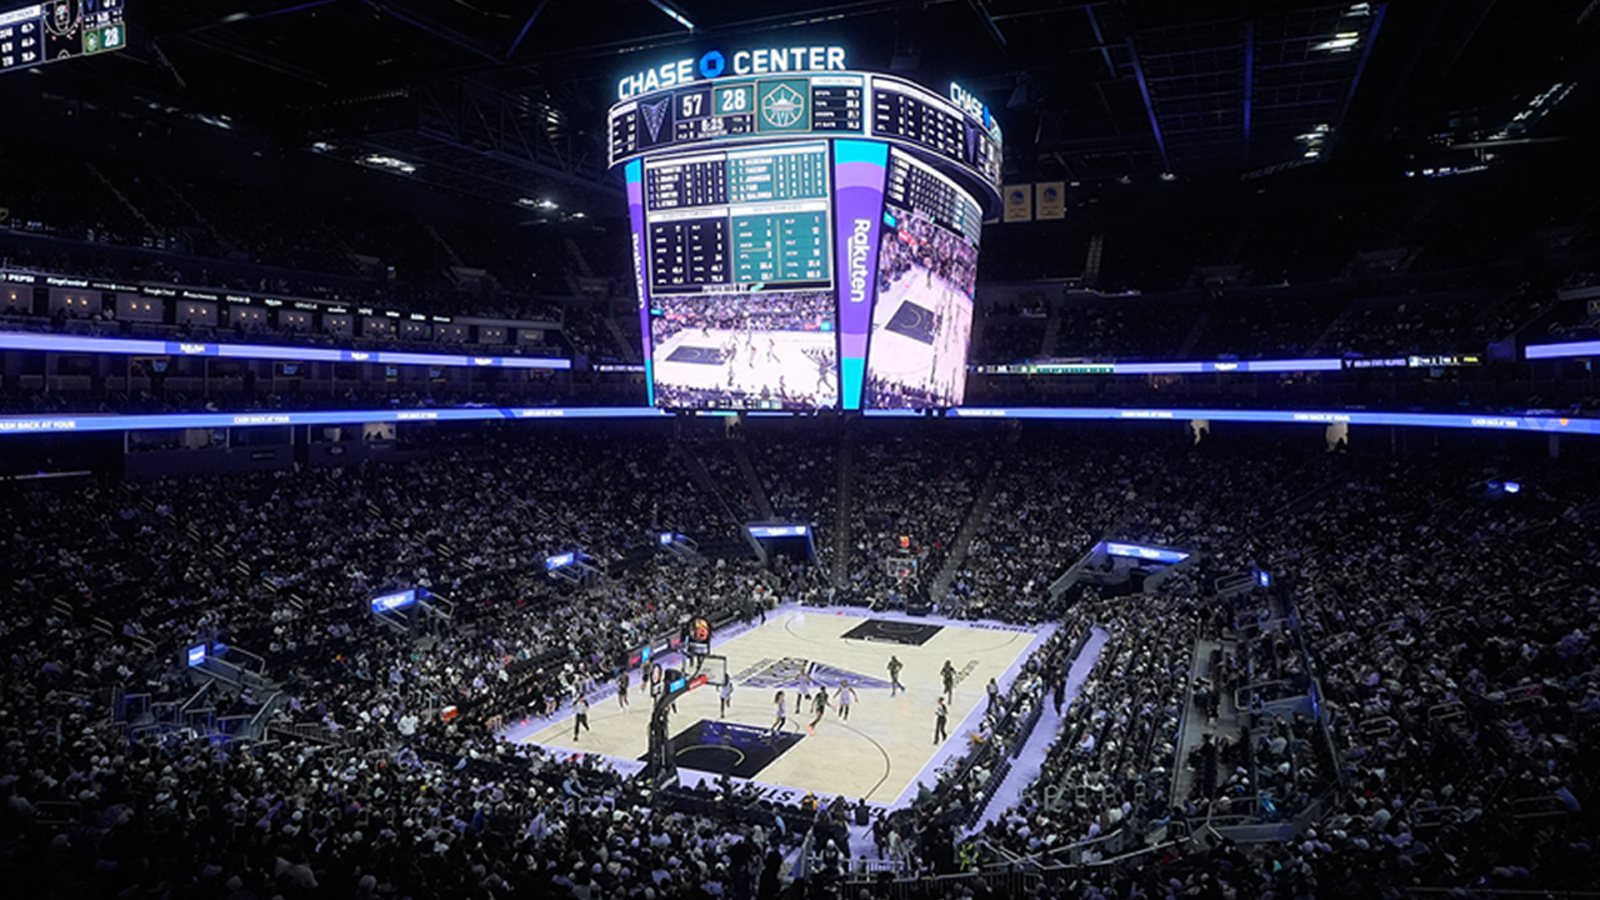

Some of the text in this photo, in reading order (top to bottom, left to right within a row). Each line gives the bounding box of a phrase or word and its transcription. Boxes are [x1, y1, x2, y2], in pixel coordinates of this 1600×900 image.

[104, 27, 119, 47] 28
[618, 46, 846, 100] CHASE CENTER
[683, 94, 702, 117] 57
[722, 88, 746, 111] 28
[850, 219, 871, 302] Rakuten
[8, 273, 35, 283] PEPSI
[17, 421, 40, 430] BACK
[40, 421, 52, 429] AT
[53, 420, 76, 429] YOUR
